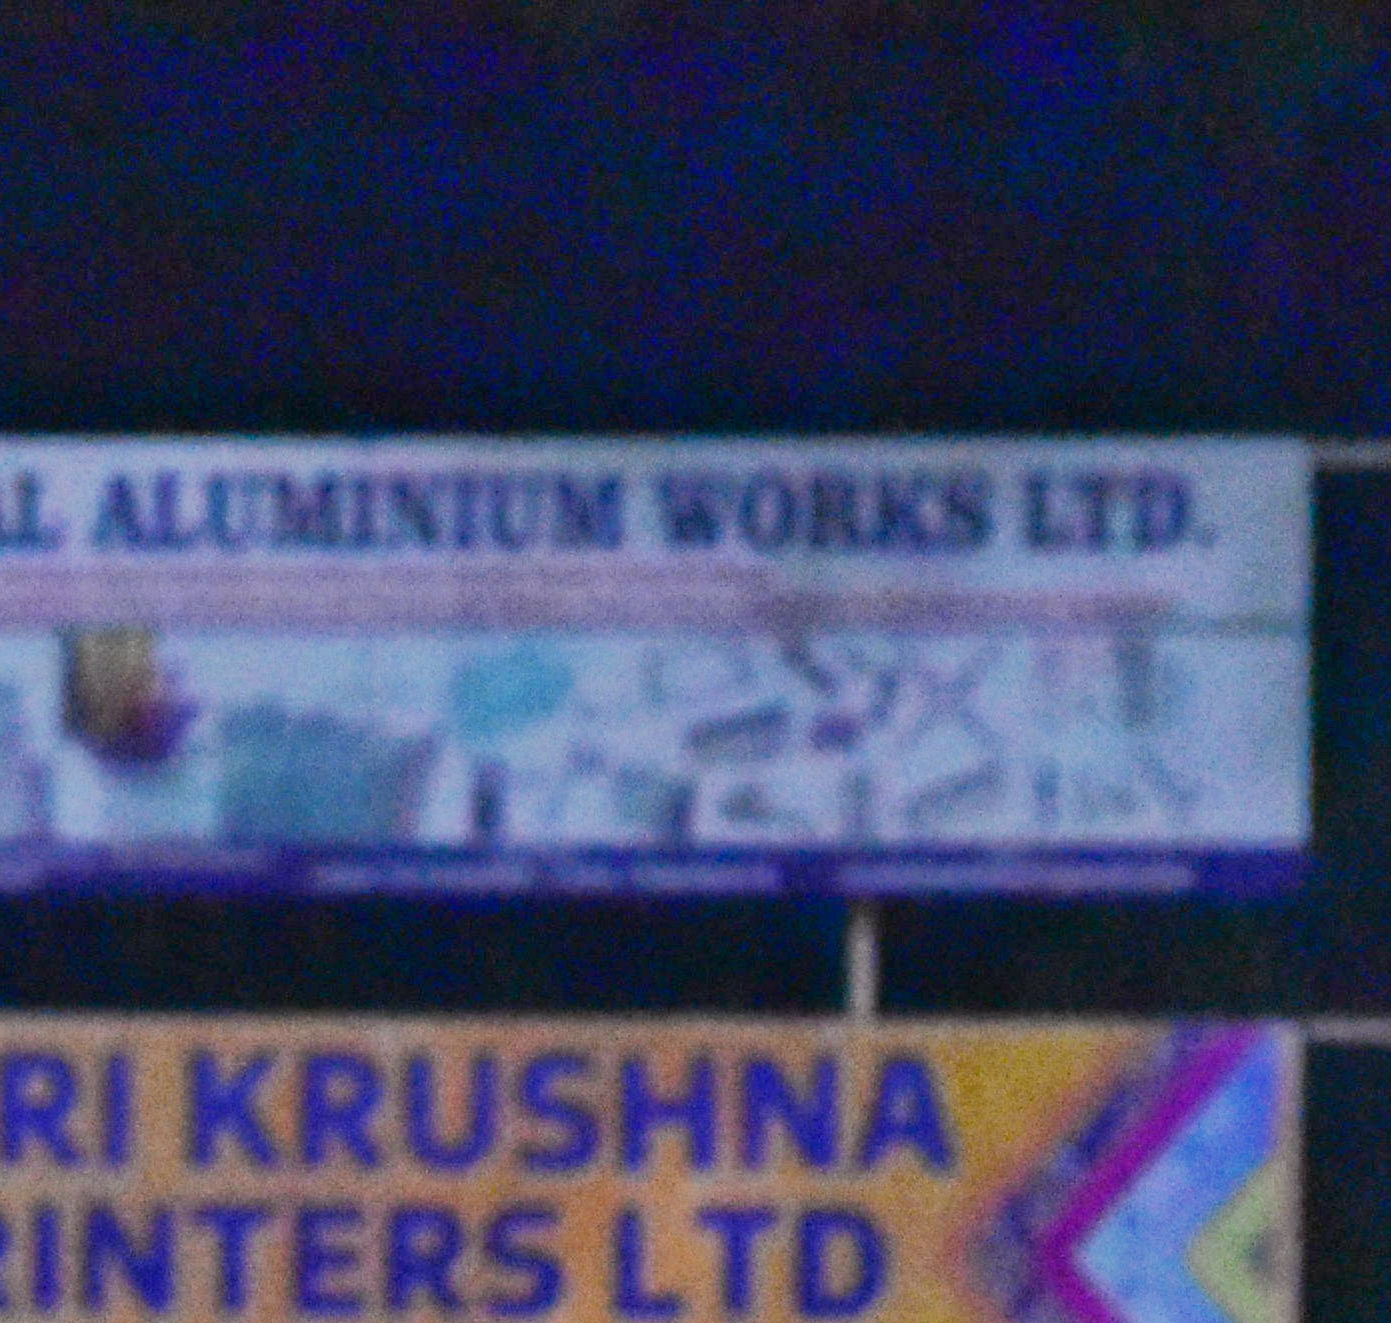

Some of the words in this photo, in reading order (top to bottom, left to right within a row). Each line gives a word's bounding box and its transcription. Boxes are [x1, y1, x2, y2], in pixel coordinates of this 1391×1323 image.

[91, 470, 622, 553] ALUMINIUM
[657, 470, 996, 555] WORKS
[186, 1049, 959, 1176] KRUSHNA
[610, 1206, 888, 1323] LTD
